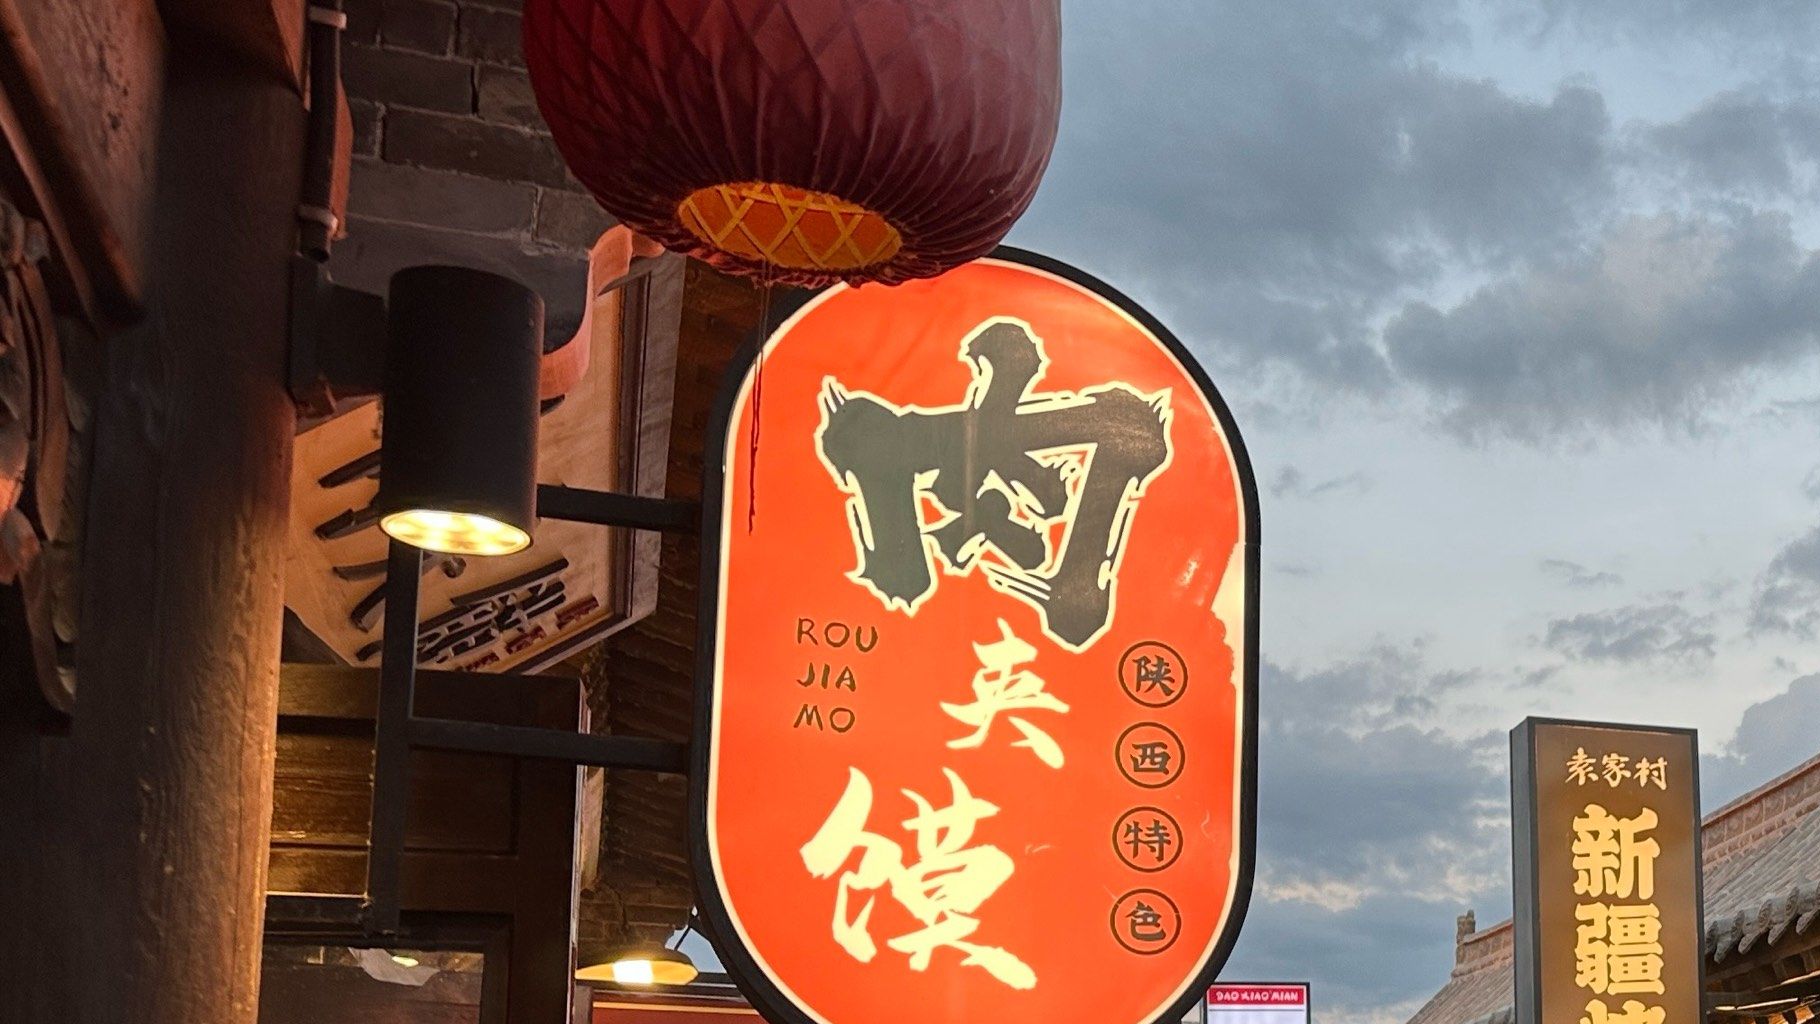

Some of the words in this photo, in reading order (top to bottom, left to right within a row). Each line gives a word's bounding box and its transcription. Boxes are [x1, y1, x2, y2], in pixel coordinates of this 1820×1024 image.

[797, 617, 878, 652] ROU
[796, 662, 856, 692] JIA
[793, 703, 855, 733] MO
[1122, 653, 1176, 943] 陕西特色
[1216, 991, 1239, 1001] DAO
[1241, 991, 1269, 1001] XIAO
[1271, 991, 1298, 1001] MIAN
